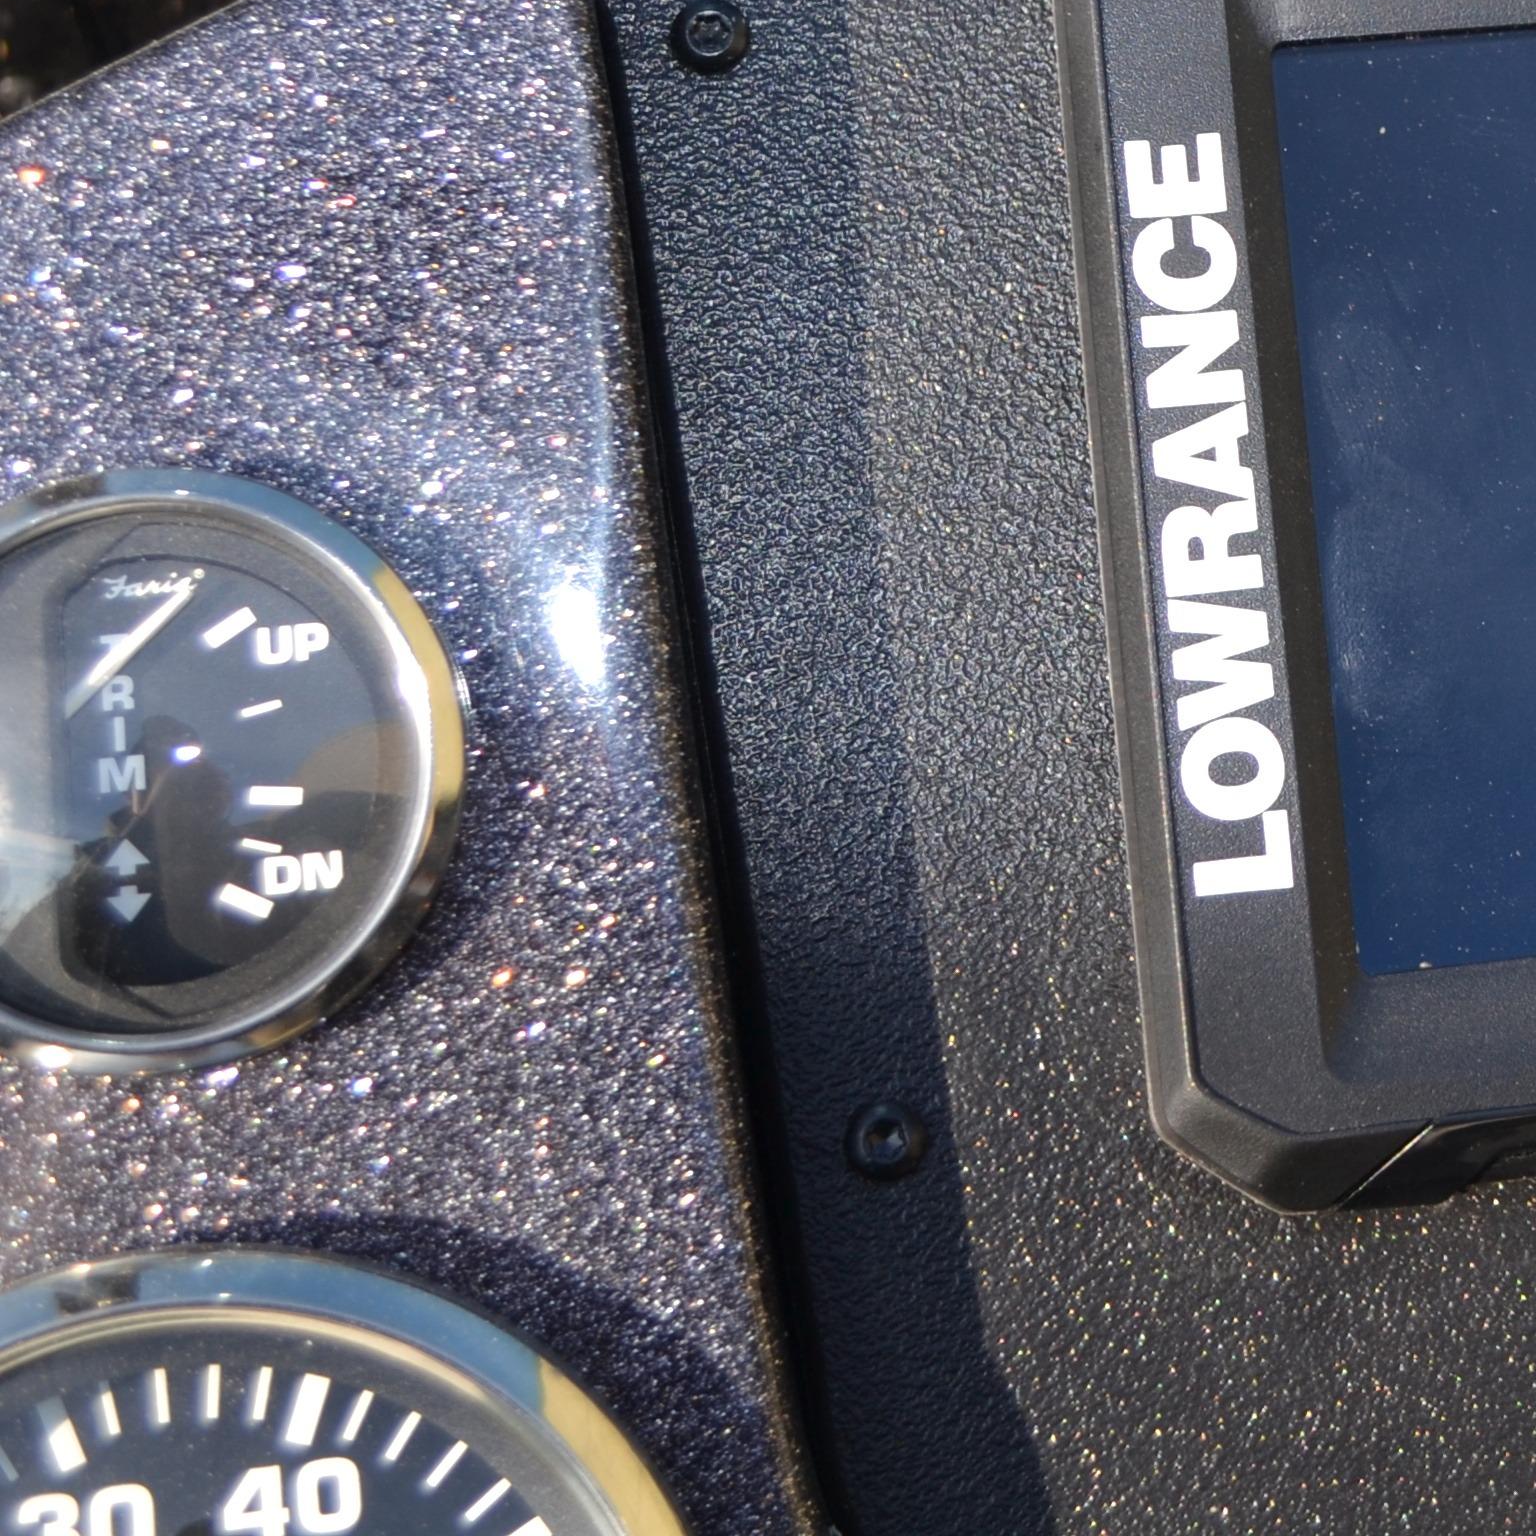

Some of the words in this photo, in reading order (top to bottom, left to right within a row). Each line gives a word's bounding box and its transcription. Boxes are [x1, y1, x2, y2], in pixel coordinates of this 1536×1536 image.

[1123, 132, 1294, 897] LOWRANCE
[256, 622, 329, 664] UP
[263, 850, 343, 895] DN
[222, 1456, 363, 1536] 40
